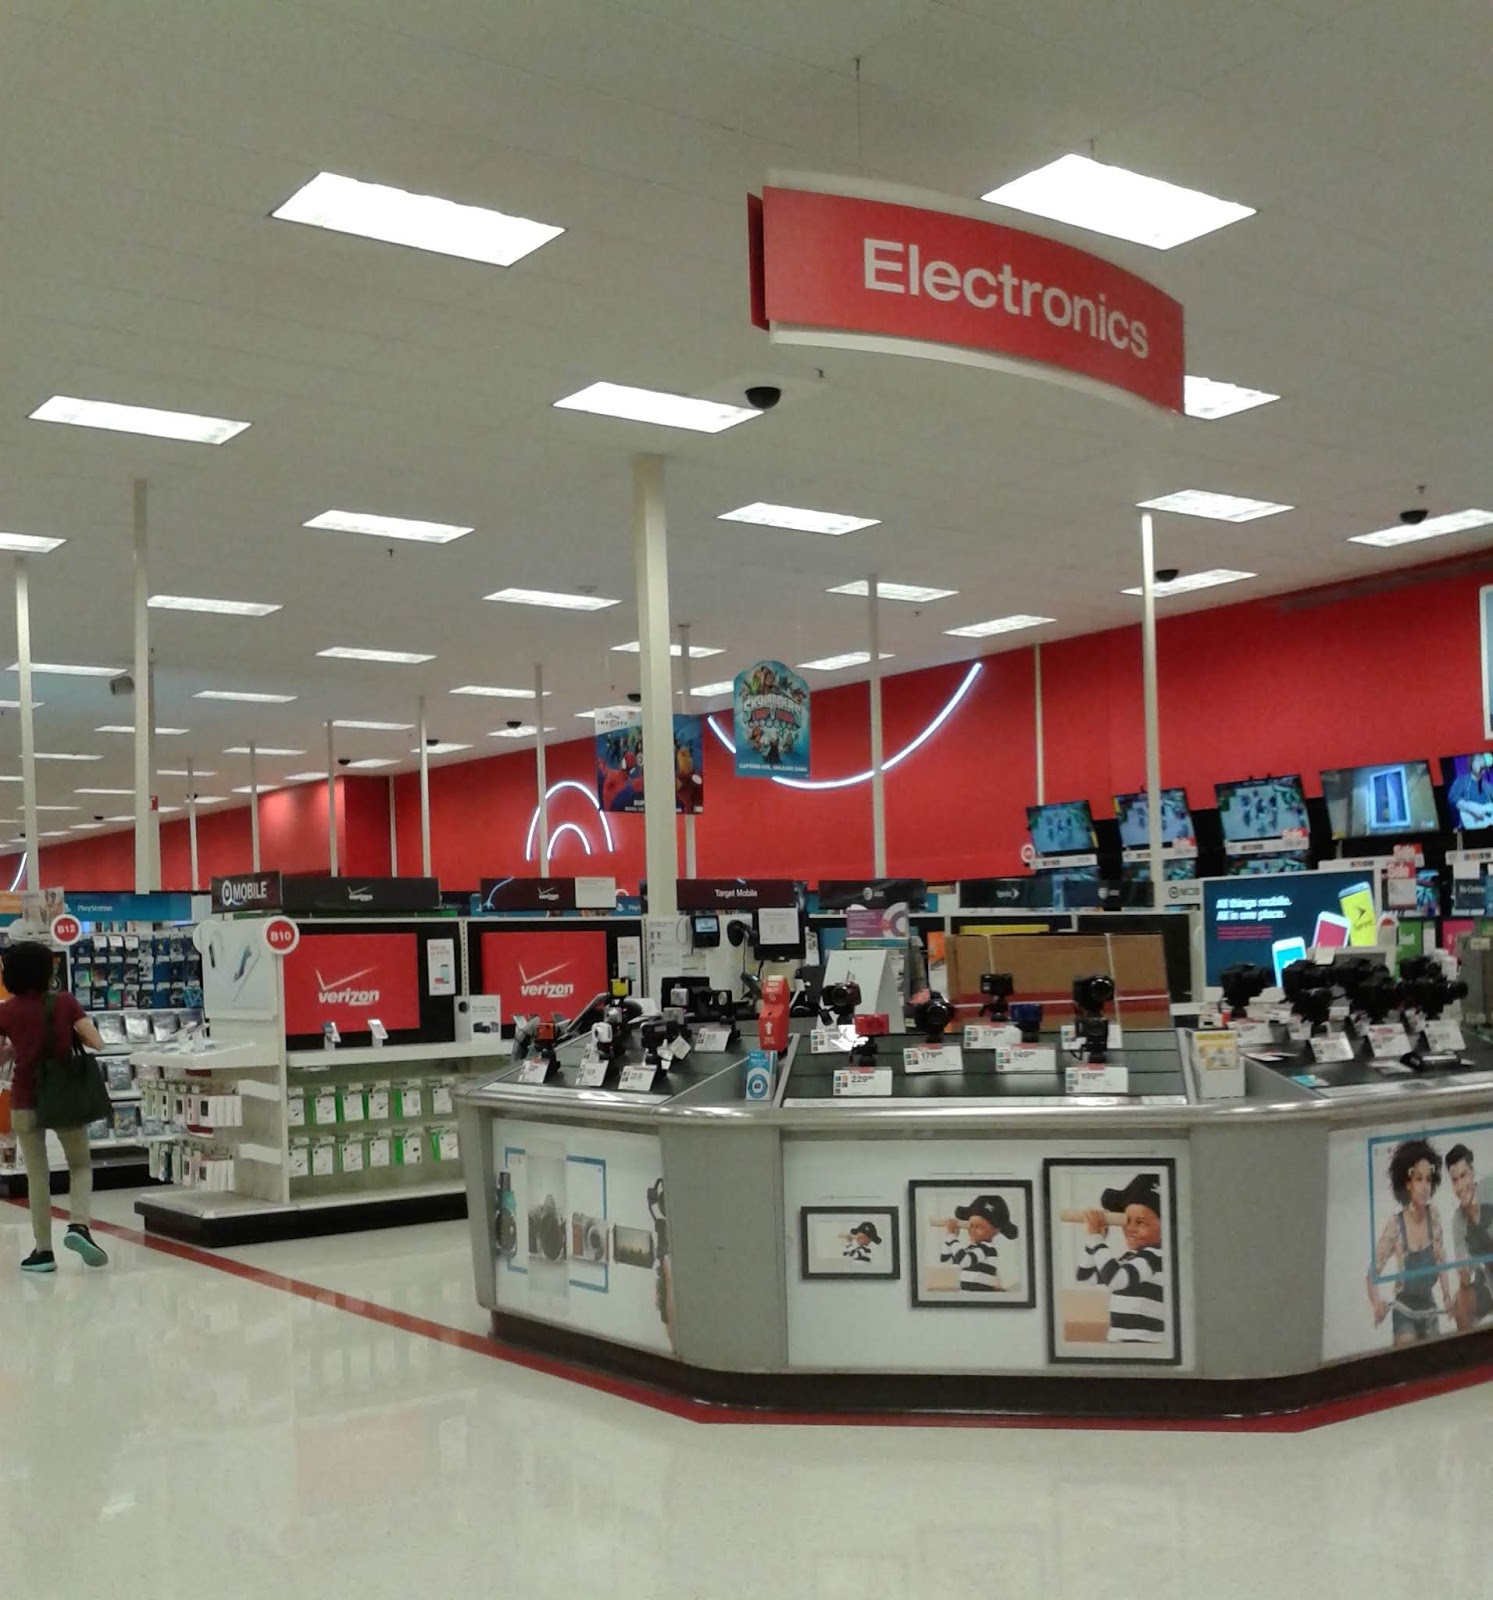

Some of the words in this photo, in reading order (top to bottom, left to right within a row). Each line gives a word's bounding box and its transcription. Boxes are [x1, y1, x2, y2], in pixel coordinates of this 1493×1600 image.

[863, 238, 1149, 359] Electronics
[233, 881, 267, 899] MOBILE
[715, 889, 735, 899] Target
[736, 889, 758, 897] Mobile
[349, 893, 374, 901] verizon
[1229, 899, 1257, 910] things
[1239, 912, 1257, 920] one
[57, 924, 76, 934] B12
[270, 931, 292, 941] B10
[521, 981, 574, 998] verizon
[318, 987, 380, 1006] verizon
